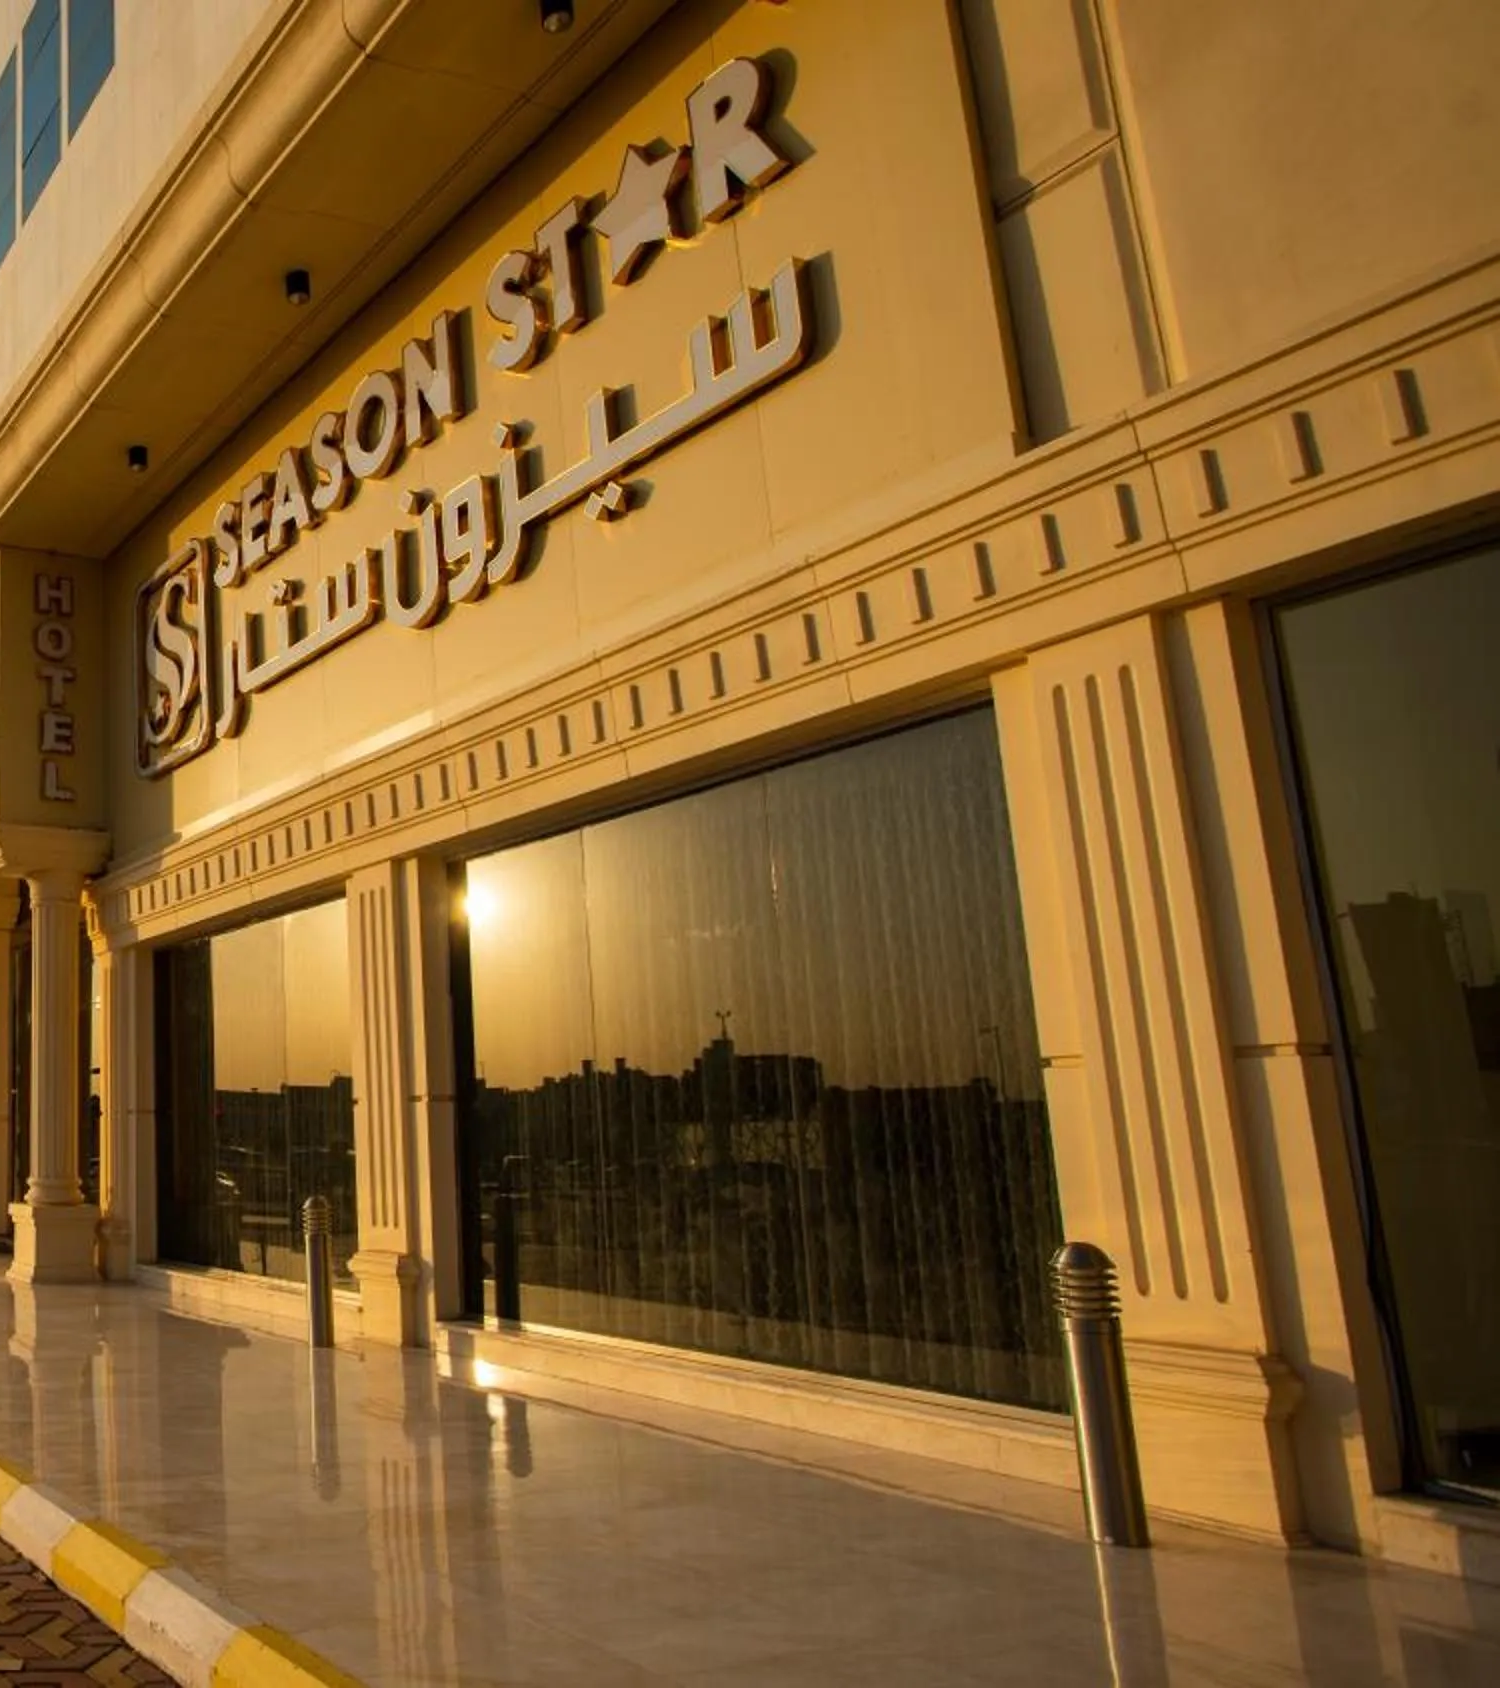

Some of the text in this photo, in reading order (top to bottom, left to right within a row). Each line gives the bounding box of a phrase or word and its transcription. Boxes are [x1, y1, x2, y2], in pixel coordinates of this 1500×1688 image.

[213, 310, 469, 586] SEASON
[215, 255, 812, 739] سيزون ستار
[34, 574, 76, 801] HOTEL
